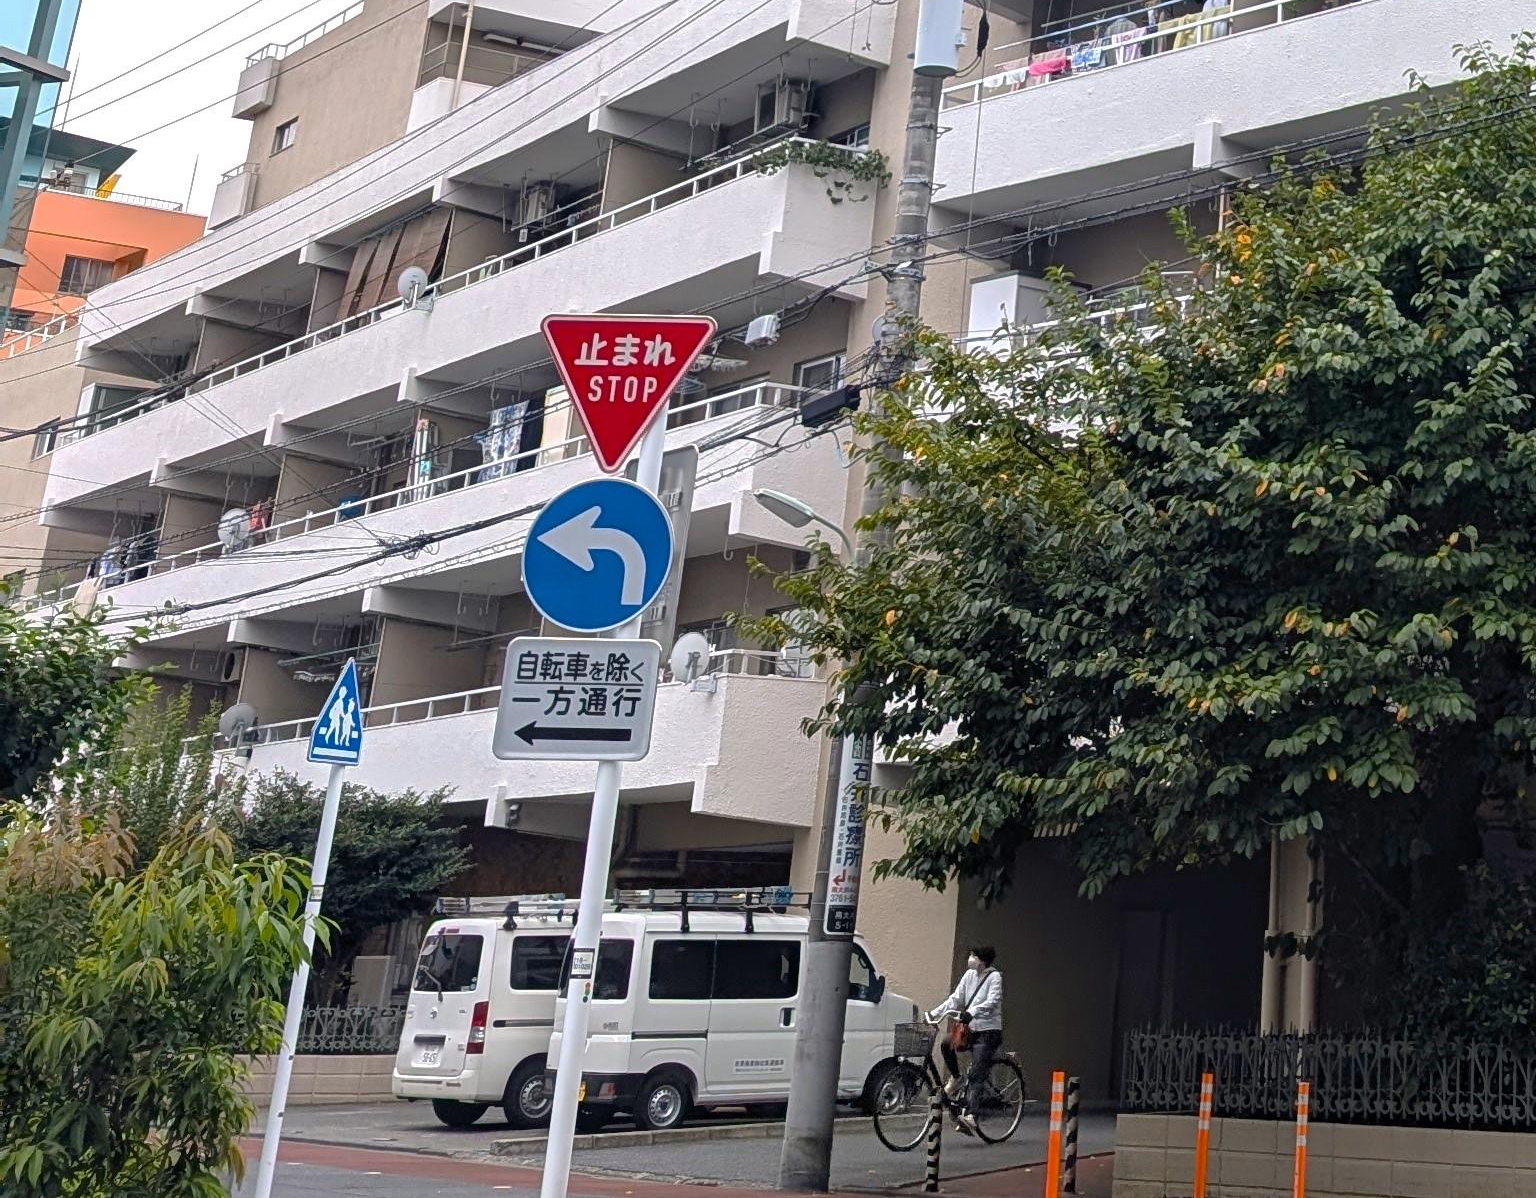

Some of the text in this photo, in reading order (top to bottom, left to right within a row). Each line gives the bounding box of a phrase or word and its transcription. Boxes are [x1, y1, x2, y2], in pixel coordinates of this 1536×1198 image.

[573, 333, 676, 368] 止まれ
[587, 376, 658, 403] STOP
[515, 650, 645, 683] 自転車を除く
[511, 686, 642, 718] 一方通行
